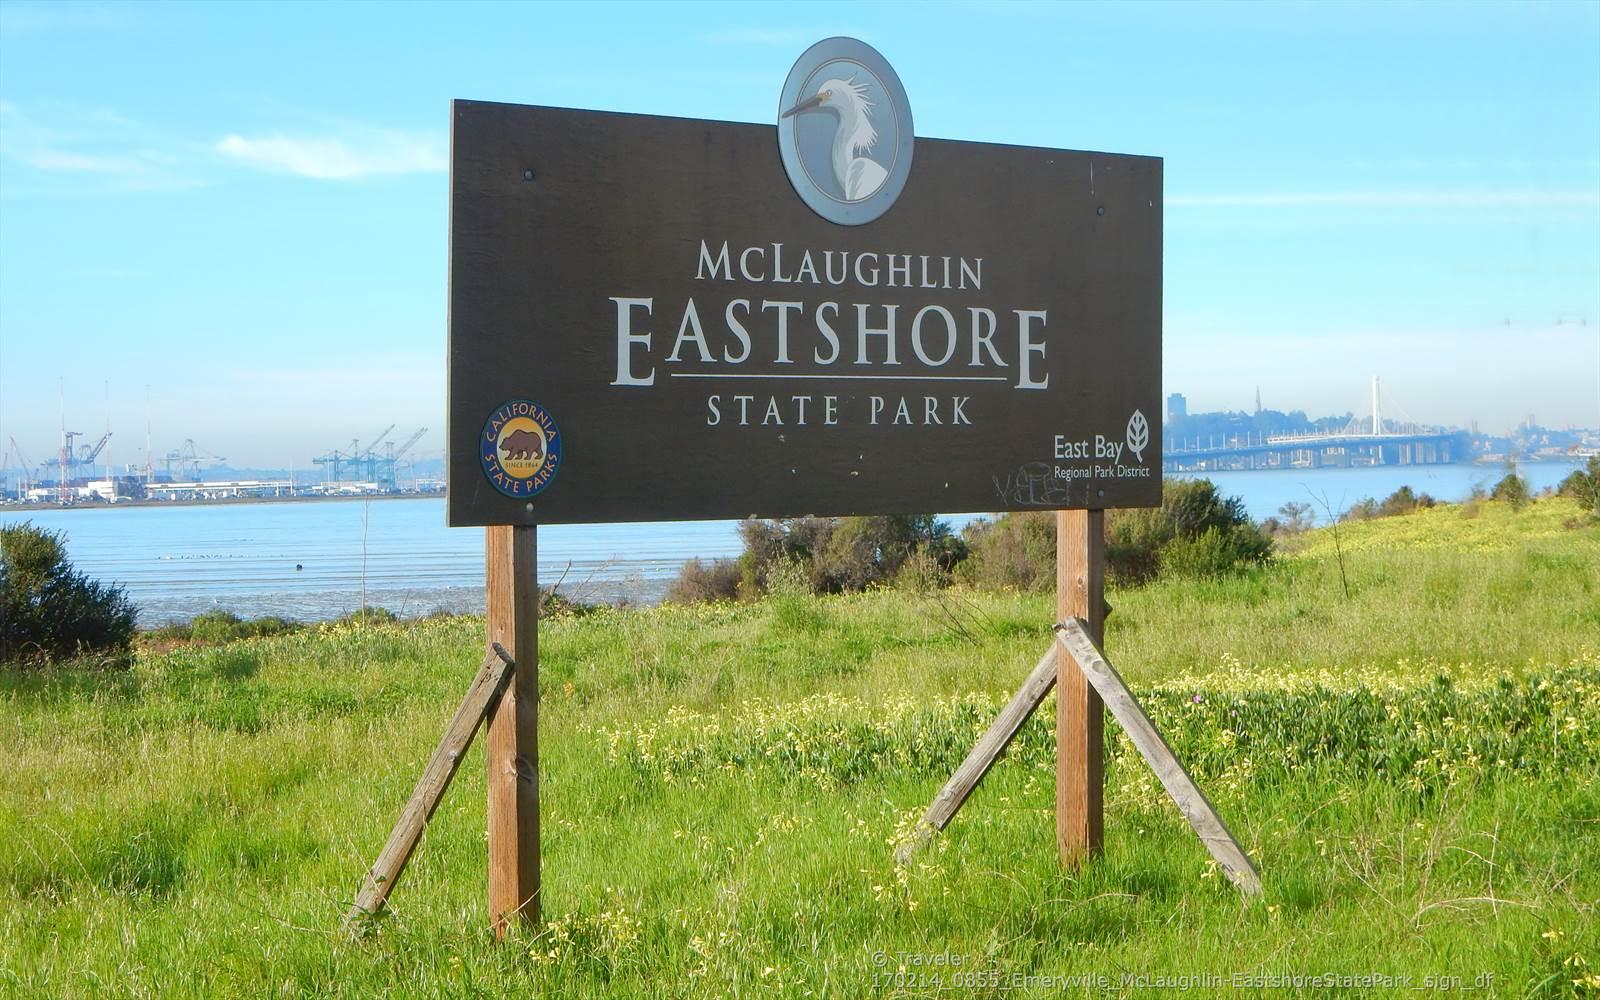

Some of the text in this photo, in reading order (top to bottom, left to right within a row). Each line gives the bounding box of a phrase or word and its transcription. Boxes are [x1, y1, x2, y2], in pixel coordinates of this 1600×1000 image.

[609, 296, 1049, 390] EASTSHORE
[486, 403, 557, 442] CALIFORNIA
[706, 395, 973, 426] STATE PARK
[1054, 434, 1124, 465] East Bay
[485, 453, 558, 493] STATE PARKS
[1054, 464, 1150, 482] Regional Park District
